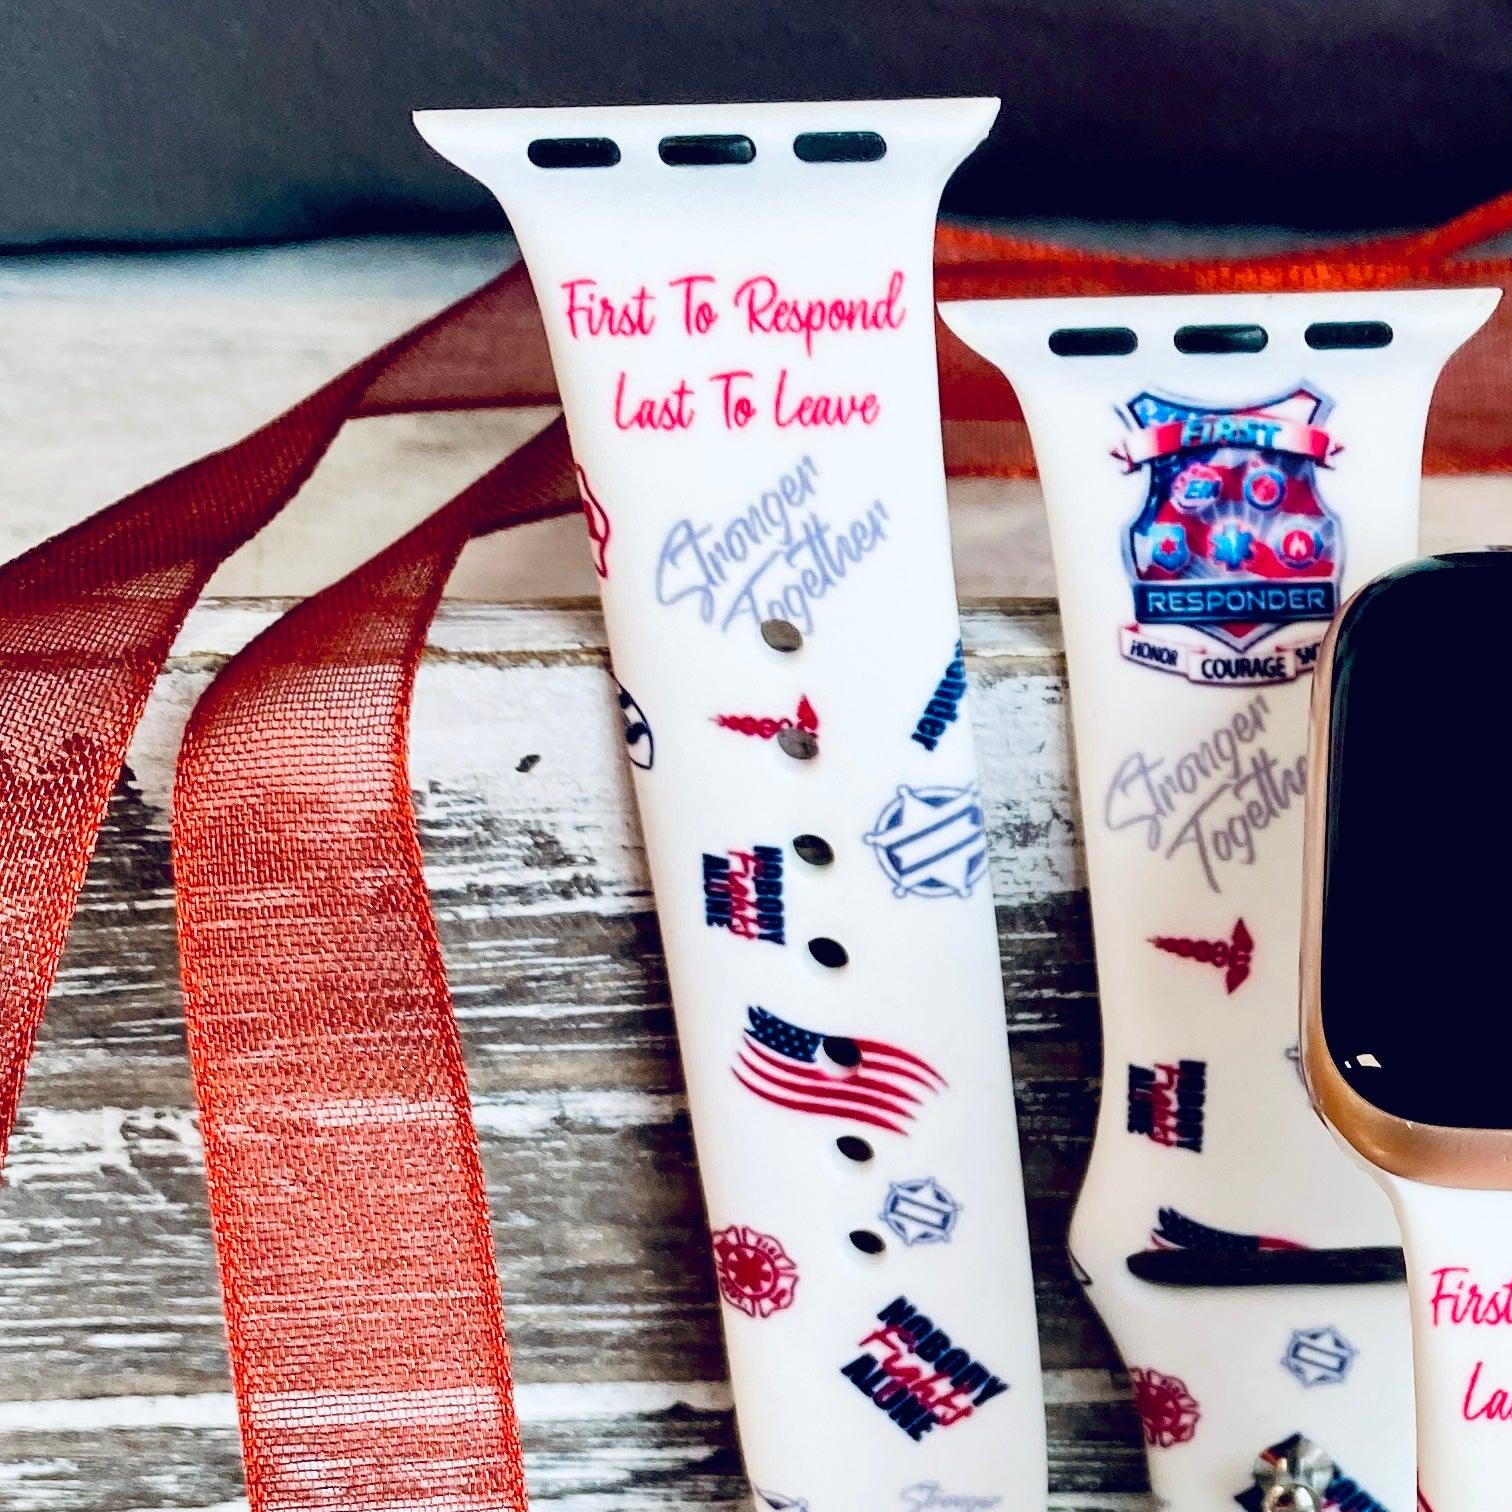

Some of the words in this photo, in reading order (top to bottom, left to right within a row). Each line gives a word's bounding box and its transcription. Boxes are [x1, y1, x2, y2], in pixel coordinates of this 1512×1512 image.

[561, 277, 657, 338] First
[669, 275, 719, 337] To
[735, 270, 907, 356] Respond
[612, 371, 696, 432] Last
[710, 370, 757, 432] To
[774, 369, 882, 430] Leave
[1181, 413, 1283, 449] FIRST
[655, 454, 820, 624] Stronger
[721, 499, 890, 639] Together
[1147, 588, 1326, 613] RESPONDER
[1130, 640, 1178, 666] HONOR
[1201, 656, 1287, 680] COURAGE
[1104, 694, 1270, 851] Stronger
[877, 1295, 1010, 1408] NOBODY
[841, 1353, 940, 1442] ALONE
